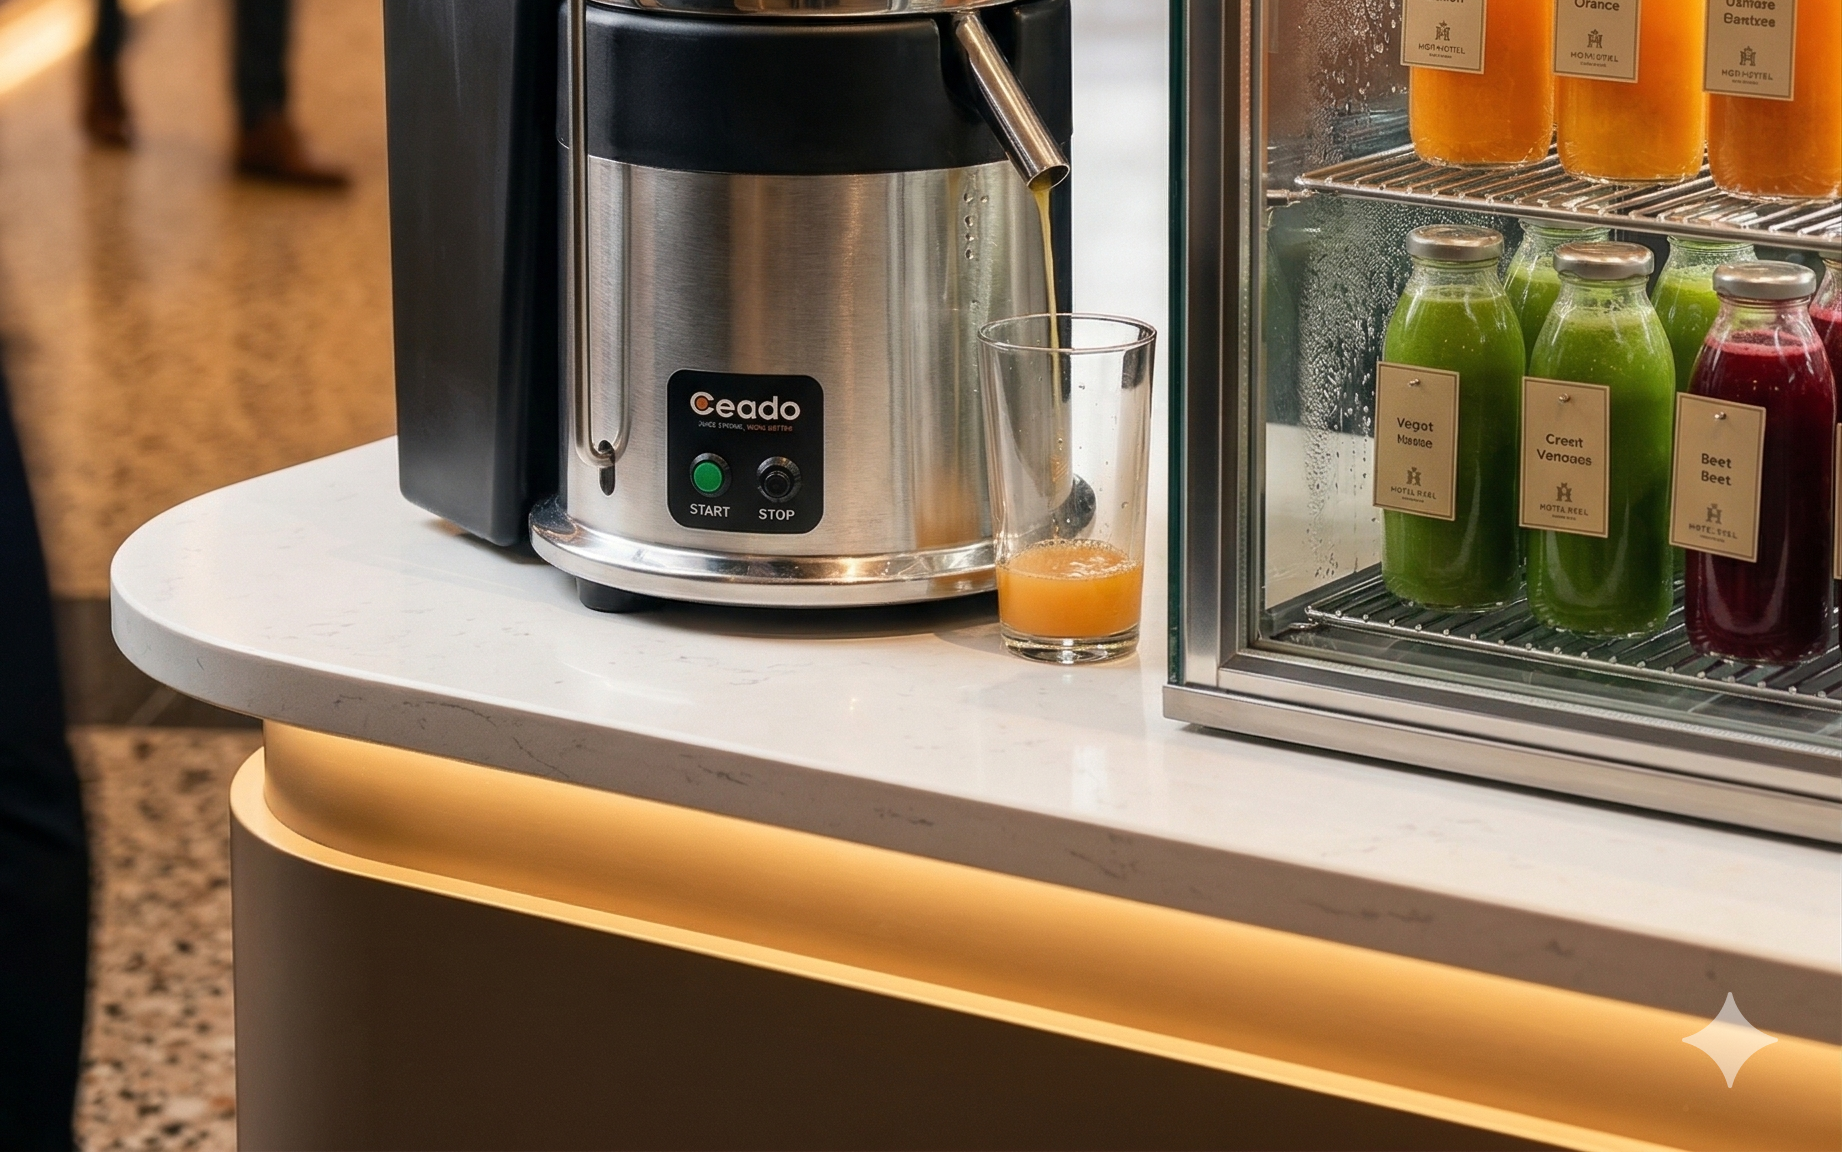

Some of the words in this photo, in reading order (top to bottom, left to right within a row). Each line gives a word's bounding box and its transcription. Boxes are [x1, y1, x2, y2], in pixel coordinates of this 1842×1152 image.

[690, 391, 801, 421] Ceado
[1397, 417, 1434, 433] Vegot
[1701, 453, 1732, 469] Beet
[1701, 470, 1732, 486] Beet
[690, 503, 731, 518] START
[758, 508, 795, 521] STOP
